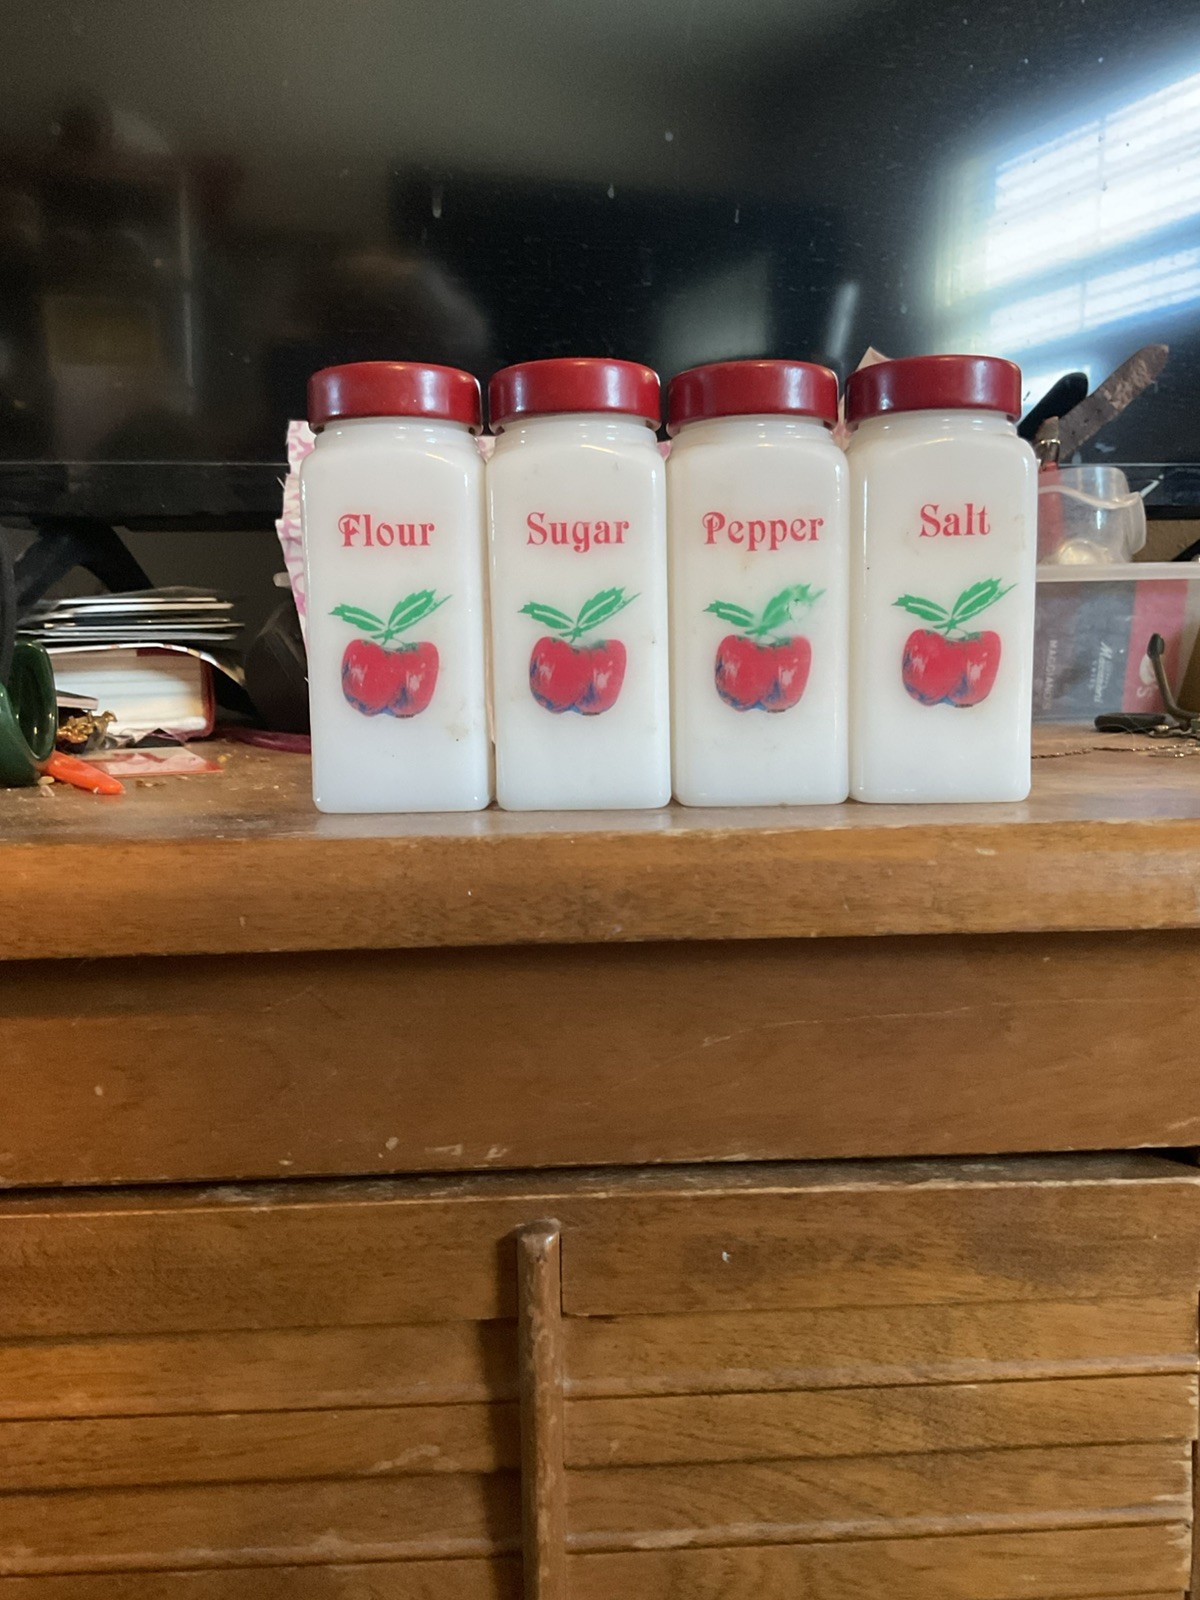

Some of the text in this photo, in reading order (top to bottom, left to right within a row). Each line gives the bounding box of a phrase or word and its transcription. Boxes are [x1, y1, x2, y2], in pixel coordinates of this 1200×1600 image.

[338, 513, 435, 547] Flour
[526, 512, 629, 553] Sugar
[702, 512, 824, 552] Pepper
[919, 503, 991, 538] Salt
